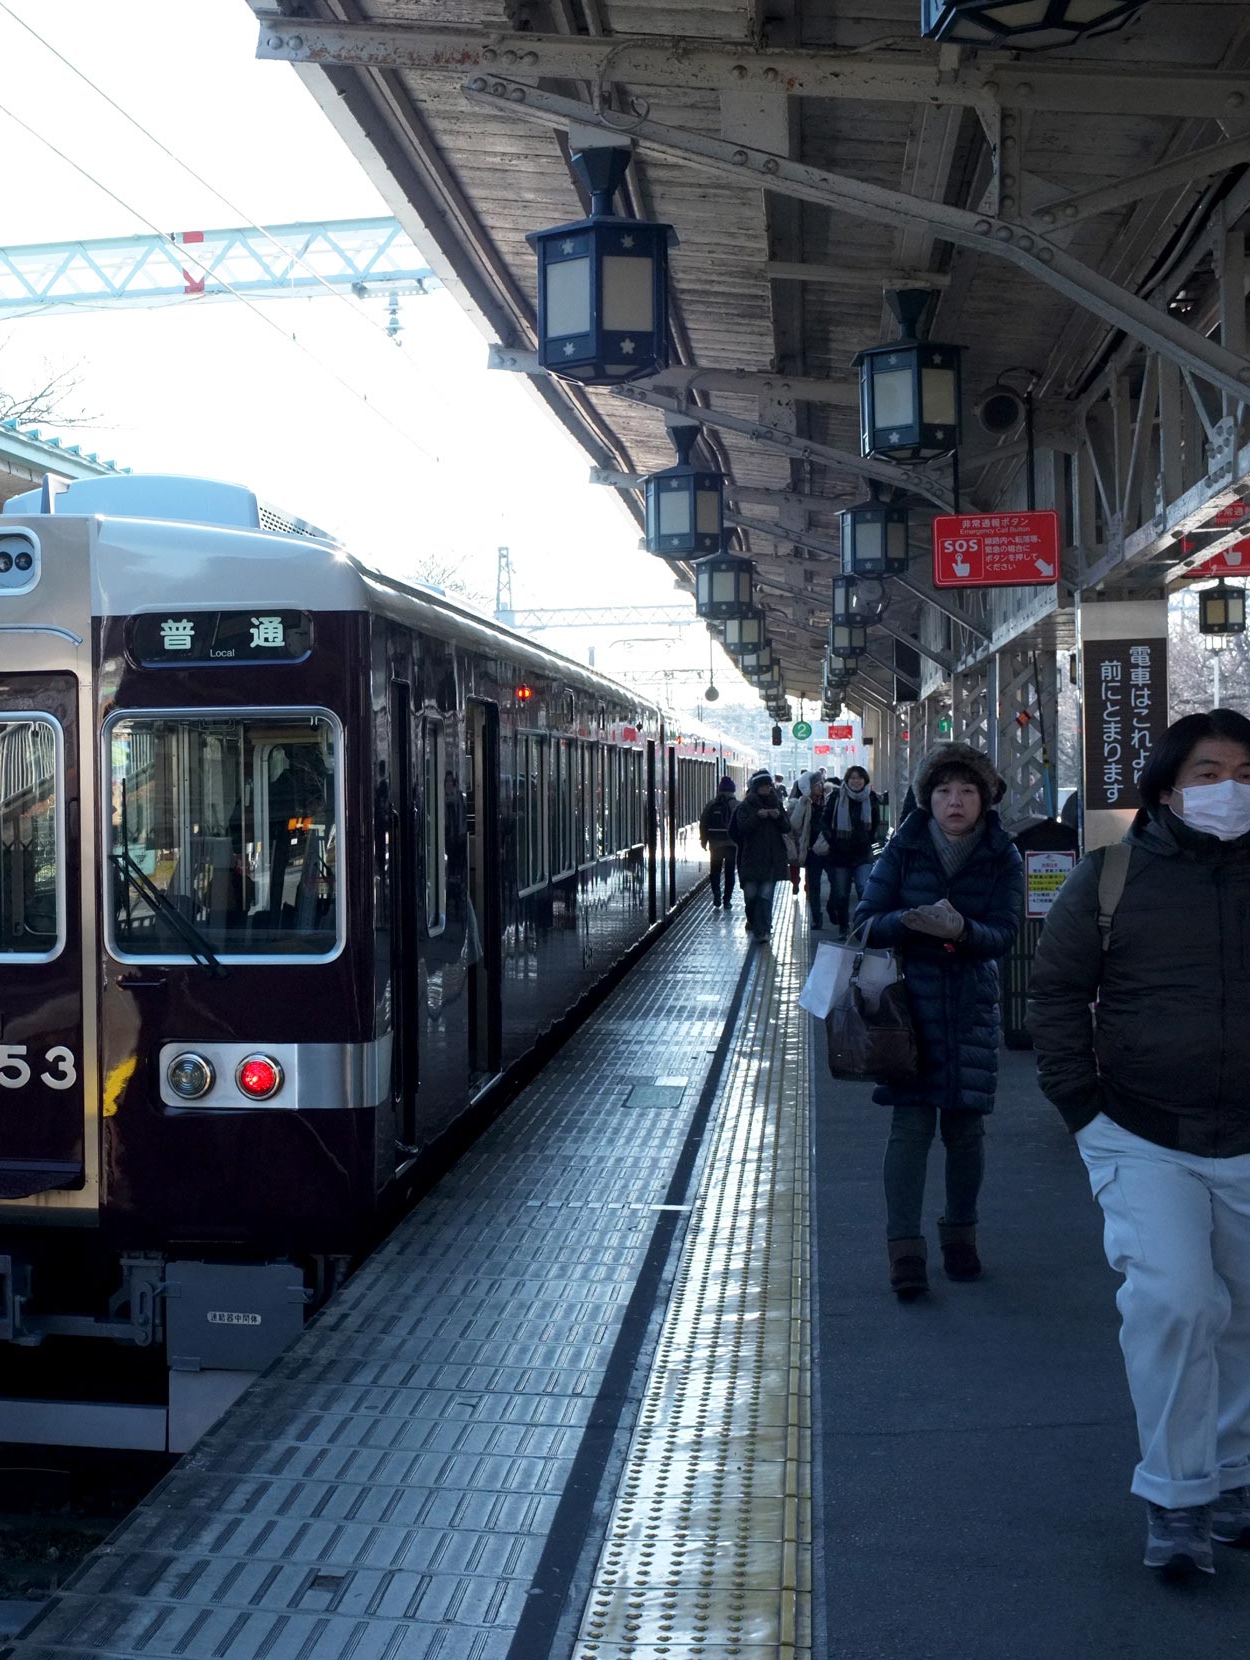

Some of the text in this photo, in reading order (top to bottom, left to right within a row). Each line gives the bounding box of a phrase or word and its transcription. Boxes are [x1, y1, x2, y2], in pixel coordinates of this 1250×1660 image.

[962, 518, 1029, 528] 非常通報ボタン
[944, 539, 978, 553] SOS
[985, 545, 1031, 554] 緊急の場合に
[985, 553, 1038, 562] ボタンを押して
[986, 563, 1017, 571] ください
[160, 616, 286, 650] 普通
[209, 648, 235, 657] Local
[1100, 660, 1124, 803] 前にとまります
